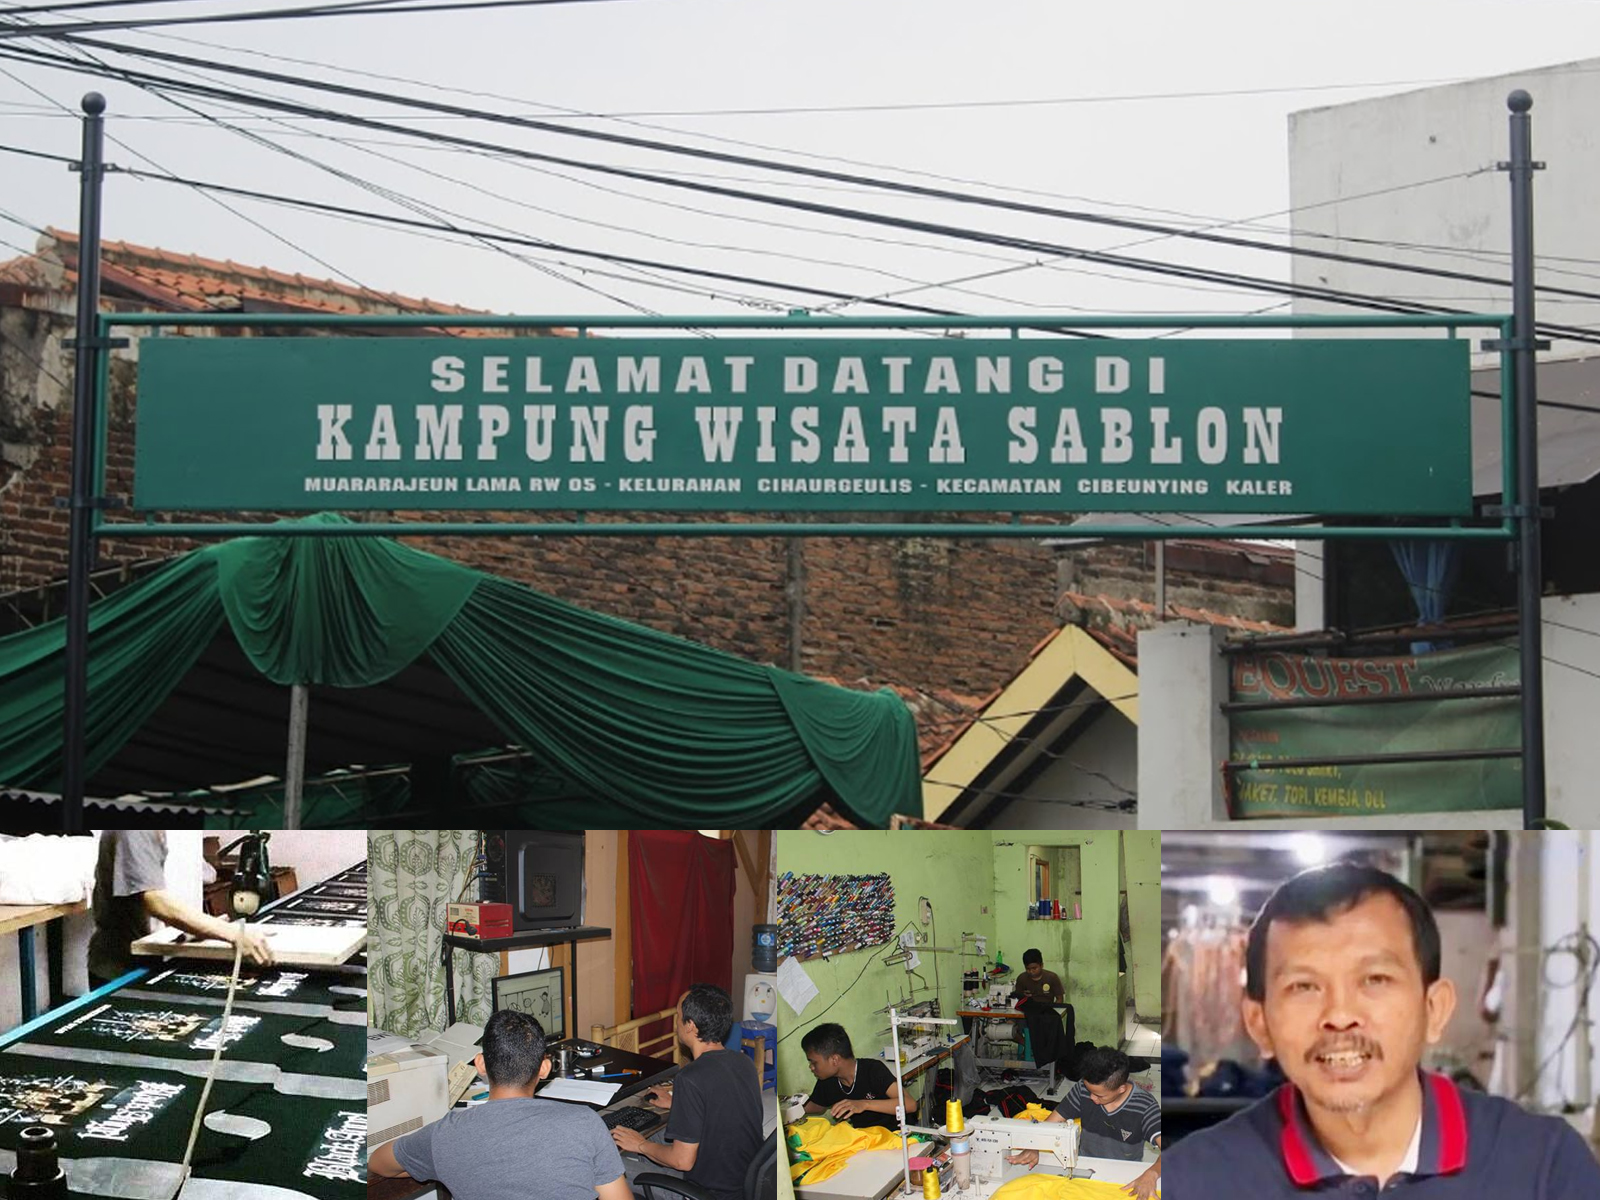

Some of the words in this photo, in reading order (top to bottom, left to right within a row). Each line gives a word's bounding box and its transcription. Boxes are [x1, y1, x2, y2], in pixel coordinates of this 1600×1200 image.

[431, 356, 754, 393] SELAMAT
[784, 357, 1063, 394] DATANG
[1095, 357, 1166, 394] DI
[316, 404, 657, 462] KAMPUNG
[695, 406, 965, 464] WISATA
[1008, 406, 1283, 465] SABLON
[305, 477, 458, 493] MUARARAJEUN
[466, 478, 521, 492] LAMA
[530, 478, 560, 492] RW
[569, 478, 597, 492] 05
[618, 478, 742, 493] KELURAHAN
[757, 478, 912, 494] CIHAURGEULIS
[936, 479, 1062, 494] KECAMATAN
[1077, 479, 1208, 495] CIBEUNYING
[1226, 480, 1293, 496] KALER
